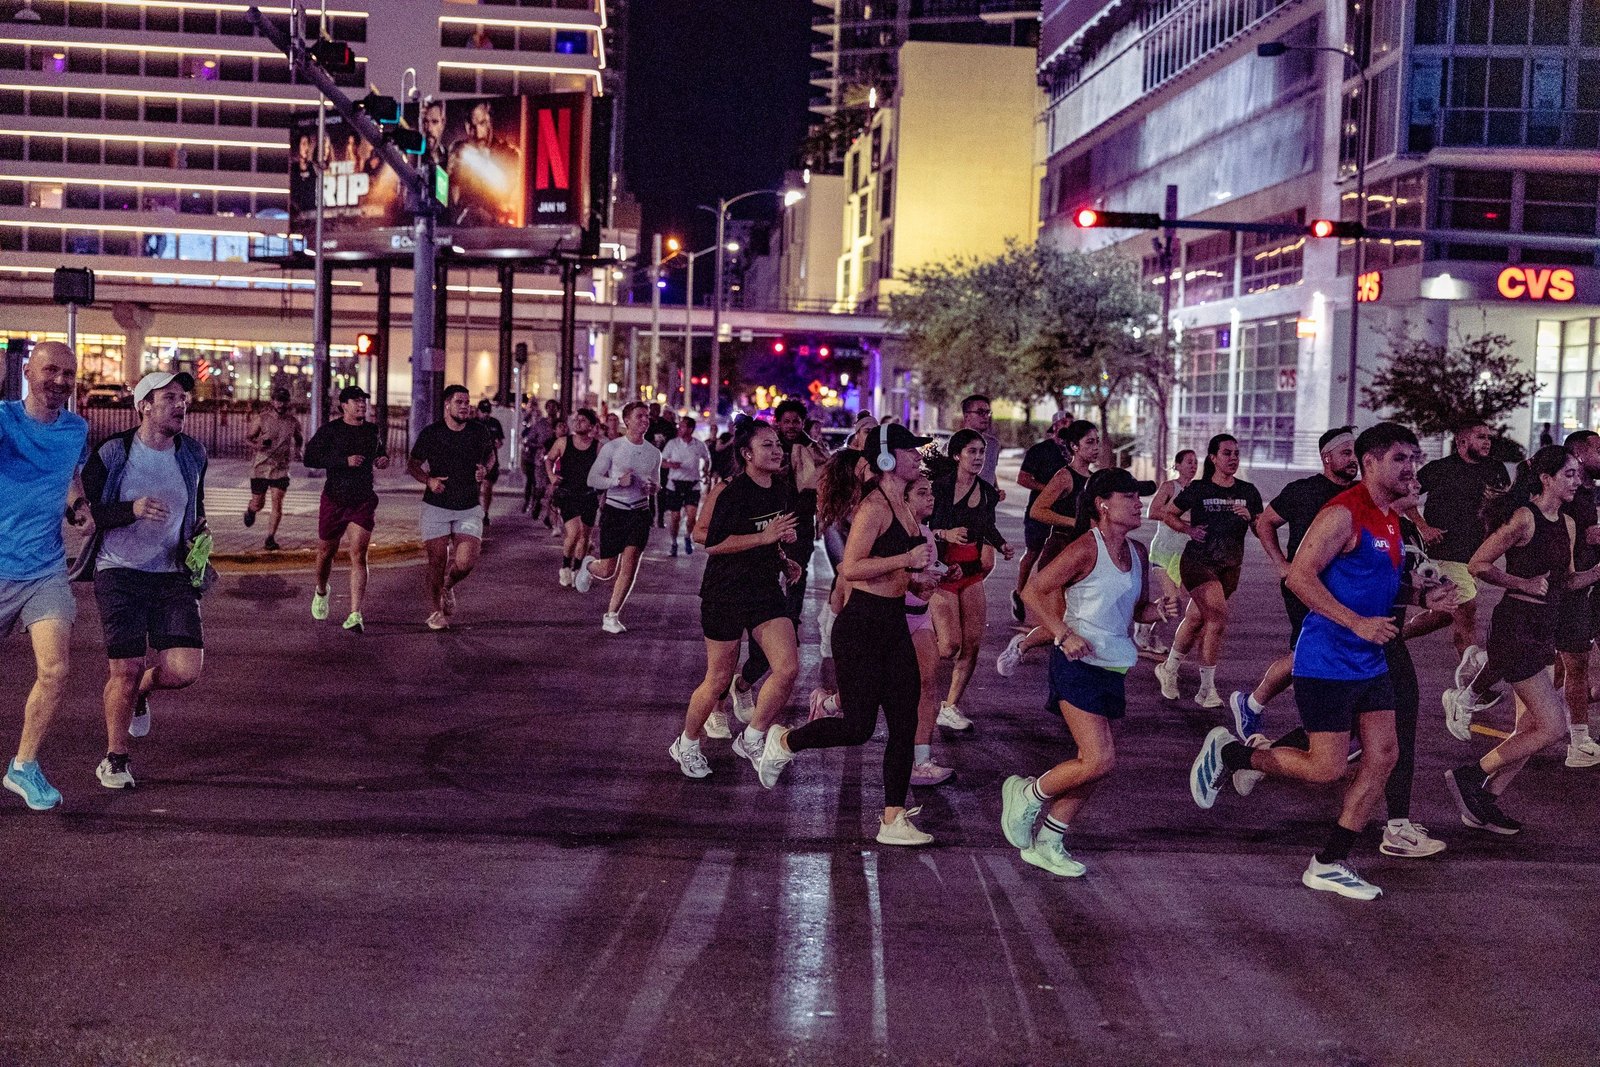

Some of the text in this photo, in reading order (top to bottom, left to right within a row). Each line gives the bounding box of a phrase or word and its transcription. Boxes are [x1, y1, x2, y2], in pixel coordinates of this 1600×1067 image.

[536, 108, 570, 190] N
[317, 172, 370, 207] RIP
[538, 202, 556, 213] JAN
[1497, 267, 1575, 301] CVS
[1374, 540, 1389, 548] AFL
